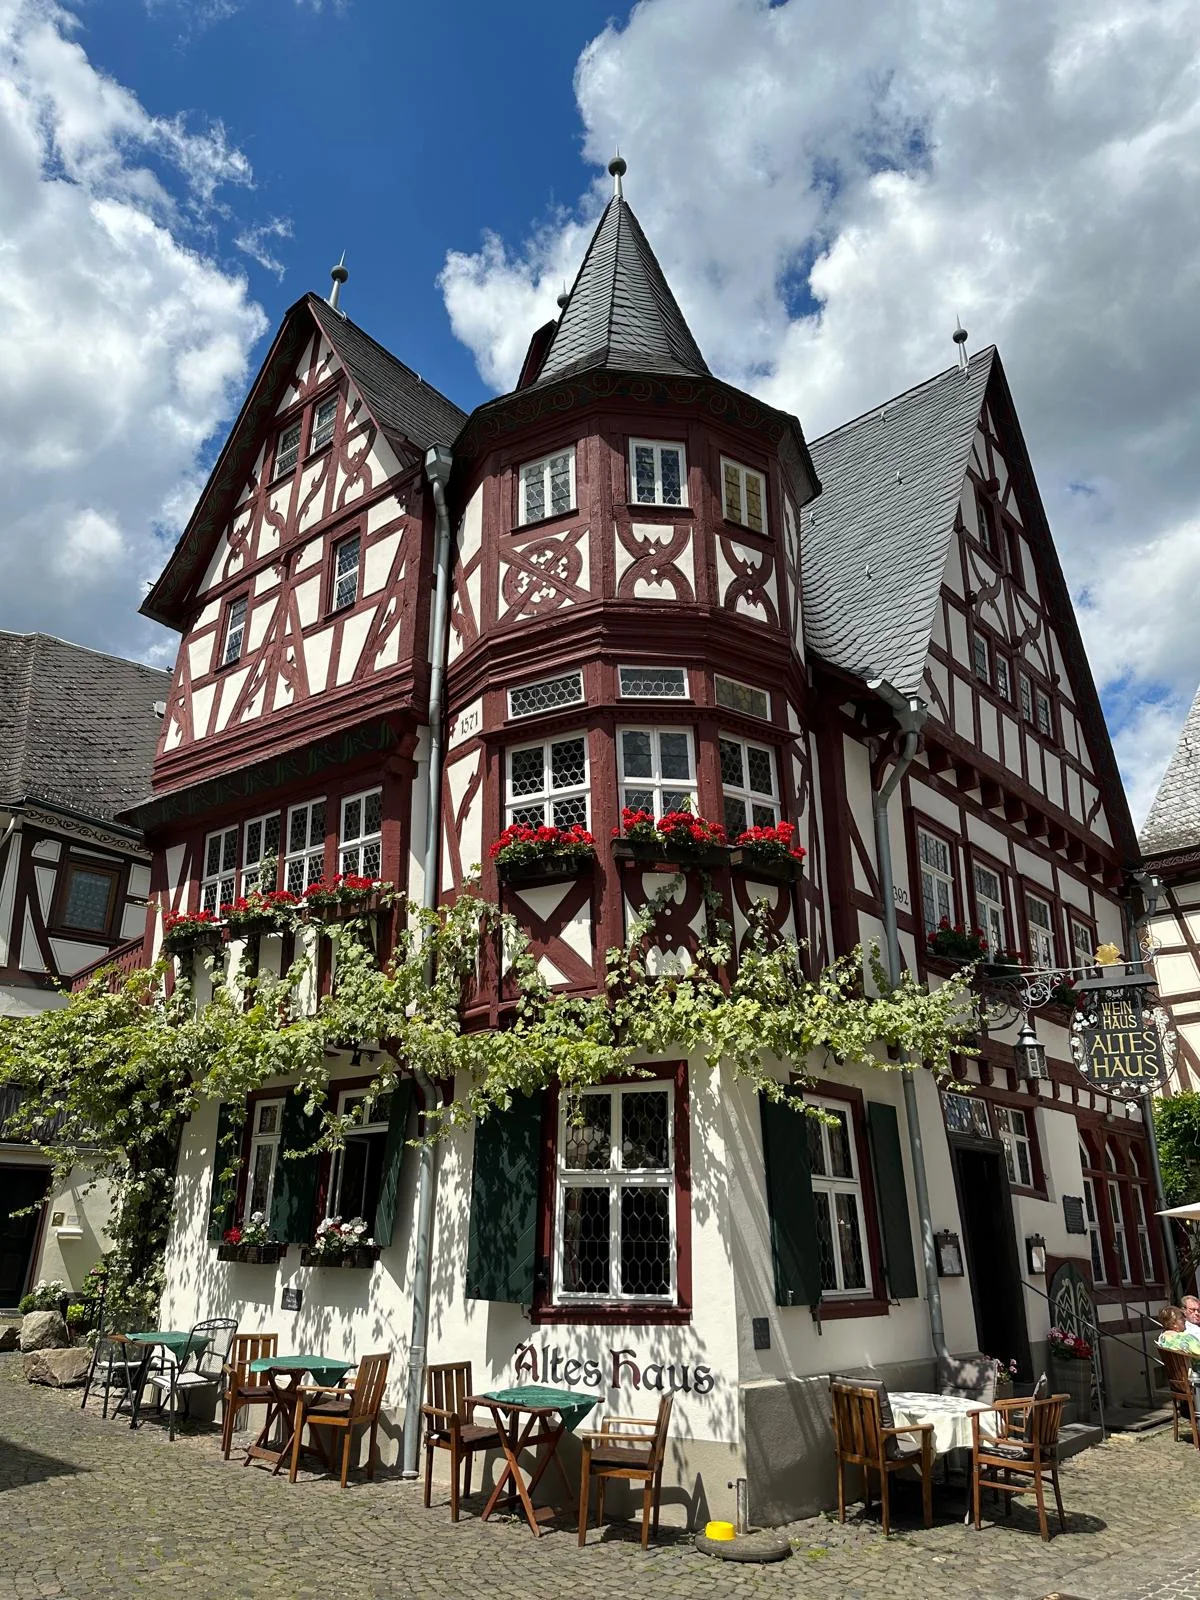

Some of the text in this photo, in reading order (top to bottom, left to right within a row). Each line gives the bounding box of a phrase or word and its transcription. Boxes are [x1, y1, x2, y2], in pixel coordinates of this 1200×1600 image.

[461, 710, 478, 736] 1571
[1101, 1000, 1133, 1016] WEIN
[1103, 1015, 1138, 1030] HAUS
[1090, 1031, 1157, 1056] ALTES
[1093, 1054, 1160, 1078] HAUS
[514, 1342, 715, 1395] Altes Haus
